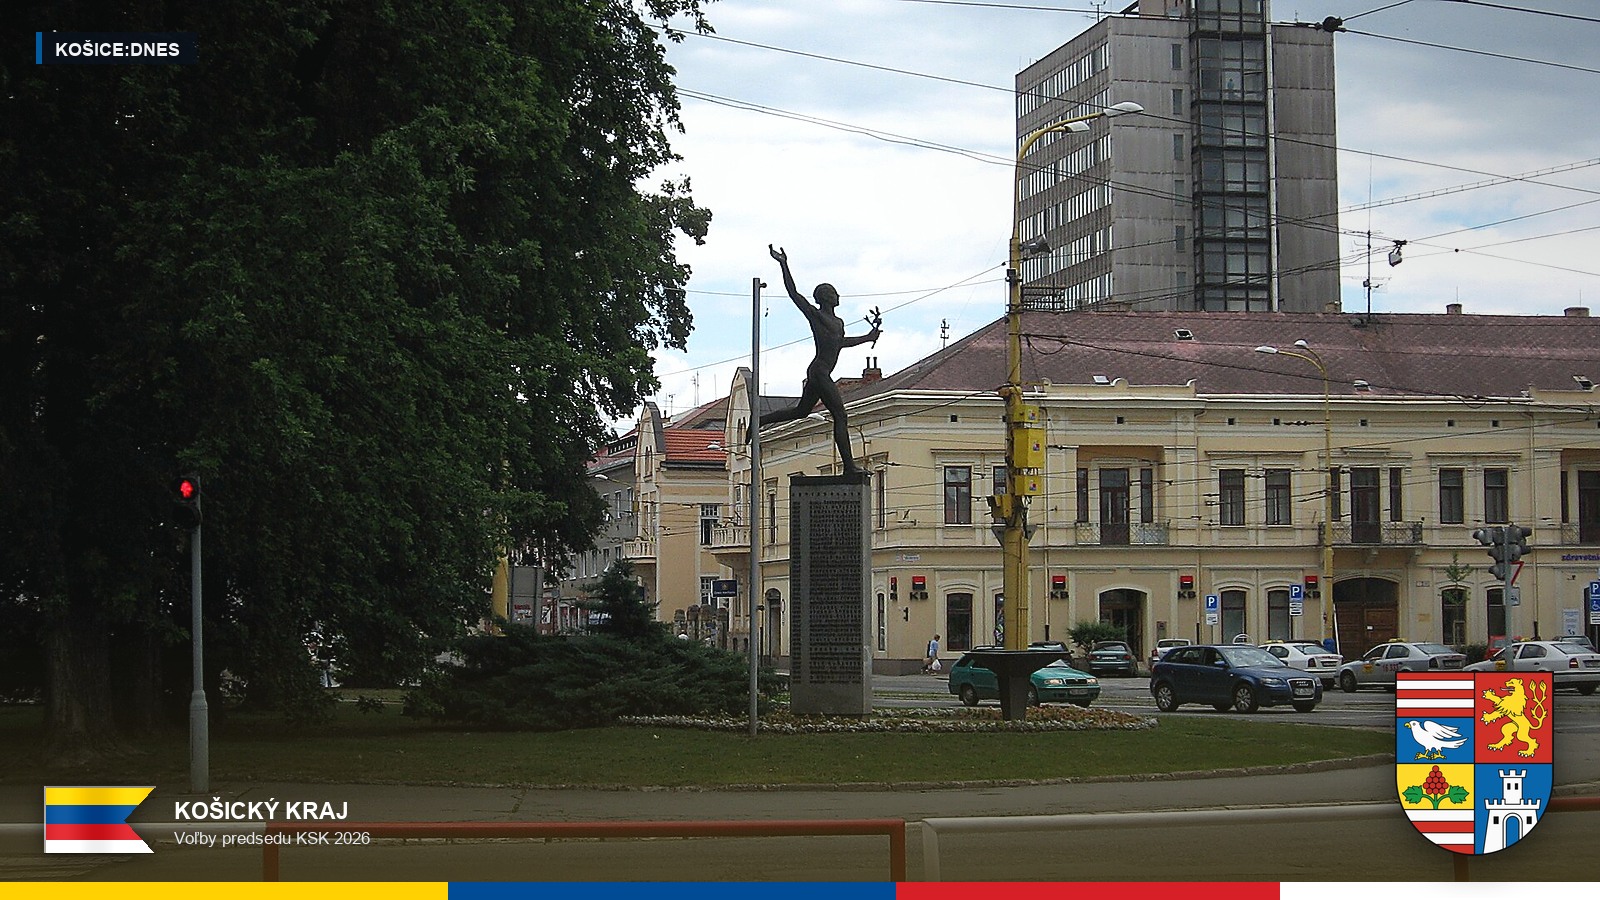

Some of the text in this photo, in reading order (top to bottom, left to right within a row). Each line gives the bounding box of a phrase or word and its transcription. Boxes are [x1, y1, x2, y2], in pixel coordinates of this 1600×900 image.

[1292, 586, 1300, 597] P
[1592, 583, 1599, 593] P
[910, 592, 929, 601] KB
[1050, 591, 1070, 600] KB
[1178, 591, 1196, 600] KB
[1303, 590, 1321, 599] KB
[1208, 596, 1216, 607] P
